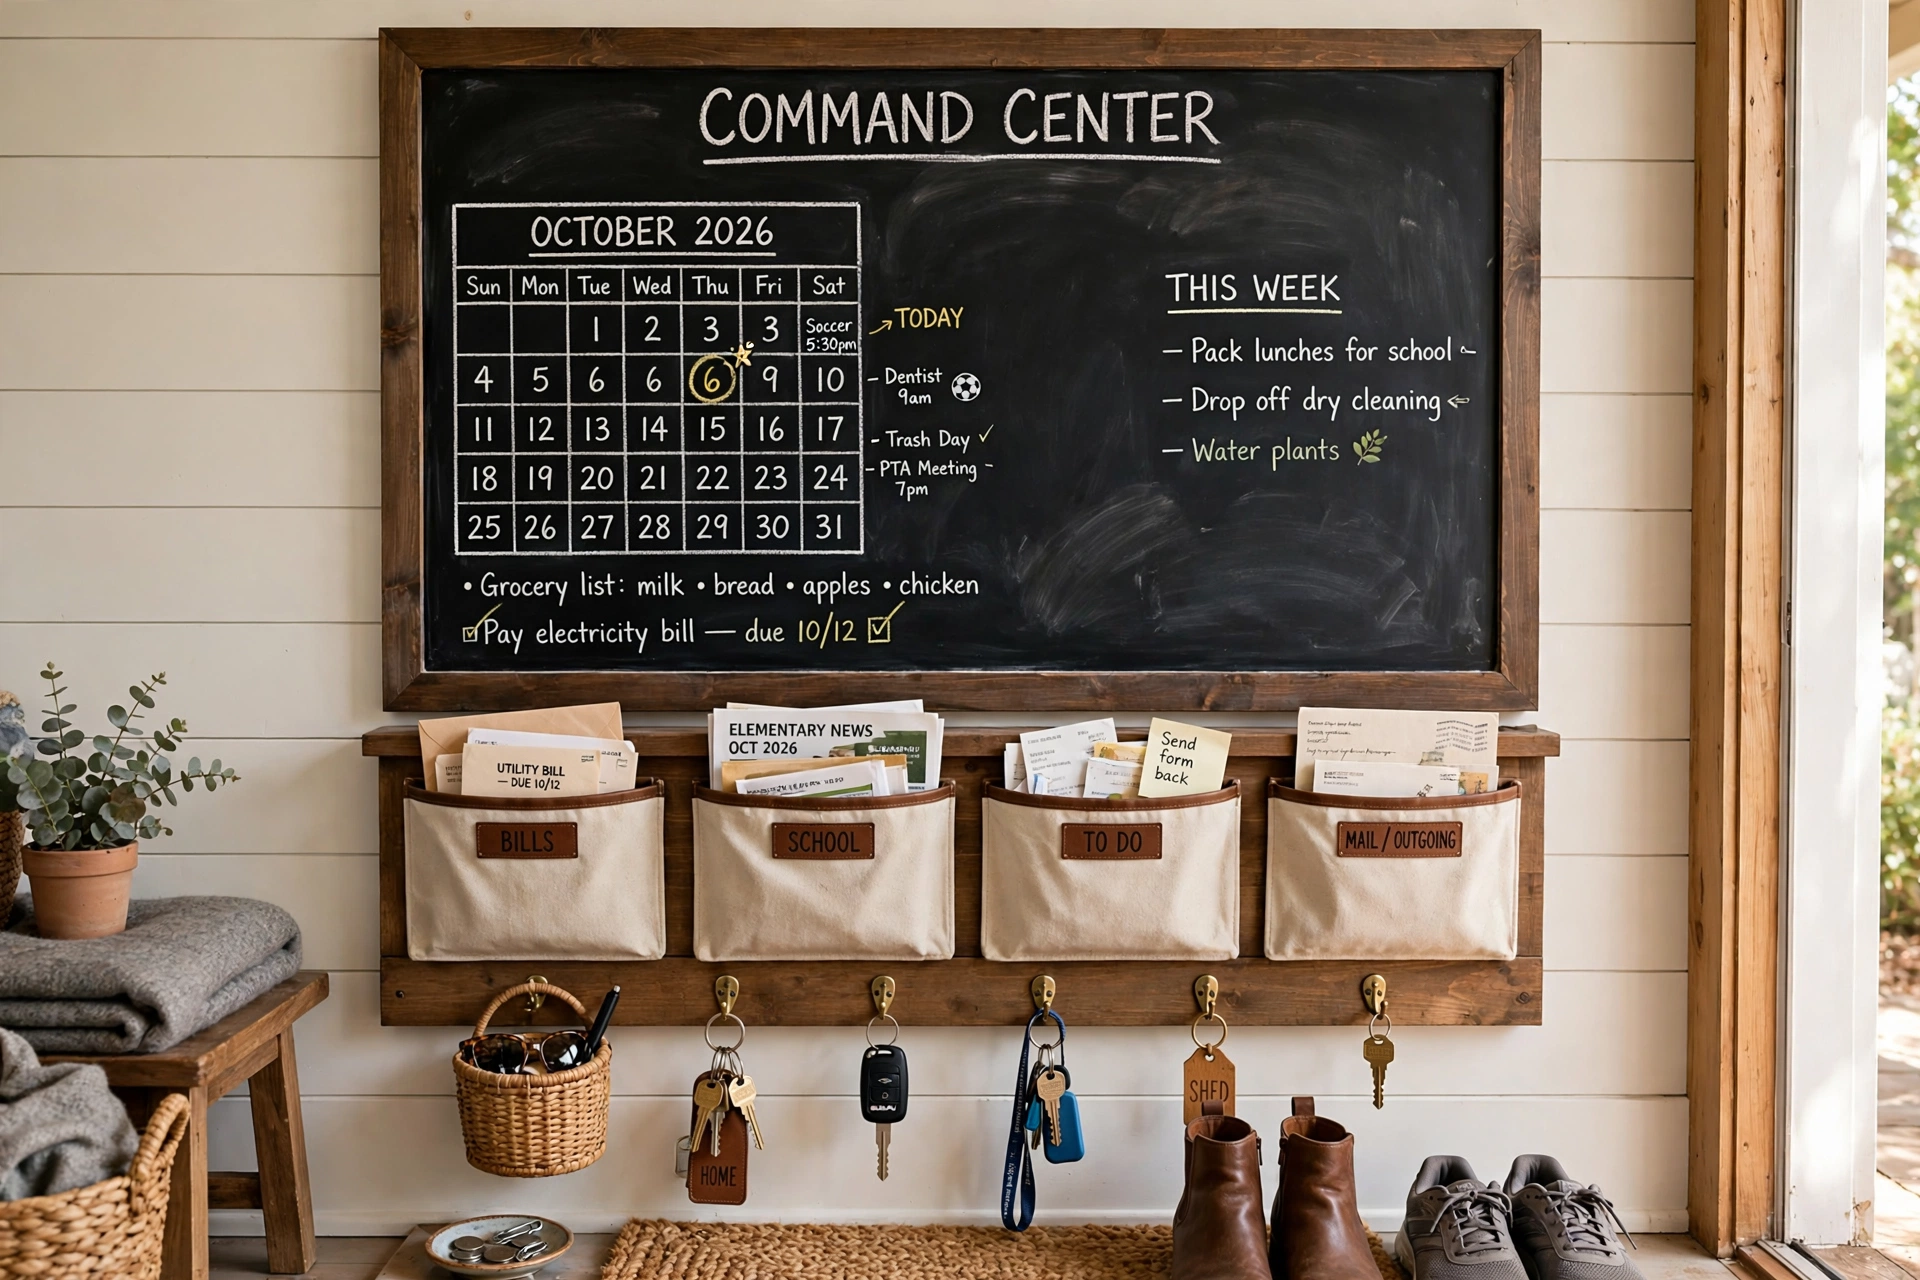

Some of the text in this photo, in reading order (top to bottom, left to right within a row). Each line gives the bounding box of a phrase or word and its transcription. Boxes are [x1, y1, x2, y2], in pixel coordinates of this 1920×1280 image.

[699, 88, 1220, 145] COMMAND CENTER
[531, 216, 773, 247] OCTOBER 2026
[467, 275, 845, 295] Sun Mon Tue Wed Thu Fri Sat
[1165, 273, 1340, 301] THIS WEEK
[807, 318, 852, 333] Soccer
[894, 307, 963, 328] TODAY
[594, 316, 778, 342] 1 2 3 3
[806, 336, 857, 353] 5:30pm
[1192, 336, 1451, 363] Pack lunches for school
[474, 366, 844, 393] 4 5 6 6 6 9 10
[886, 368, 942, 384] Dentist
[899, 388, 931, 405] 9am
[1192, 386, 1440, 421] Drop off dry cleaning
[476, 416, 843, 441] 11 12 13 14 15 16 17
[885, 430, 970, 453] Trash Day
[1192, 437, 1339, 471] Water plants
[474, 465, 848, 491] 18 19 20 21 22 23 24
[880, 460, 976, 482] PTA Meeting
[896, 481, 928, 501] 7pm
[468, 514, 841, 539] 25 26 27 28 29 30 31
[481, 571, 978, 605] Grocery list: milk bread apples chicken
[484, 618, 523, 654] Pay
[536, 619, 648, 653] electricity
[662, 618, 693, 642] bill
[746, 618, 784, 642] due
[799, 612, 856, 649] 10/12
[730, 723, 873, 737] ELEMENTARY NEWS
[1162, 731, 1197, 751] Send
[729, 741, 797, 754] OCT 2026
[1159, 749, 1194, 768] form
[497, 763, 565, 777] UTILITY BILL
[1154, 766, 1188, 786] back
[512, 778, 531, 788] DUE
[534, 777, 561, 791] 10/12
[501, 830, 554, 852] BILLS
[788, 831, 860, 853] SCHOOL
[1083, 831, 1142, 853] TO DO
[1345, 830, 1378, 850] MAIL
[1394, 830, 1456, 850] OUTGOING
[701, 1166, 737, 1186] HOME
